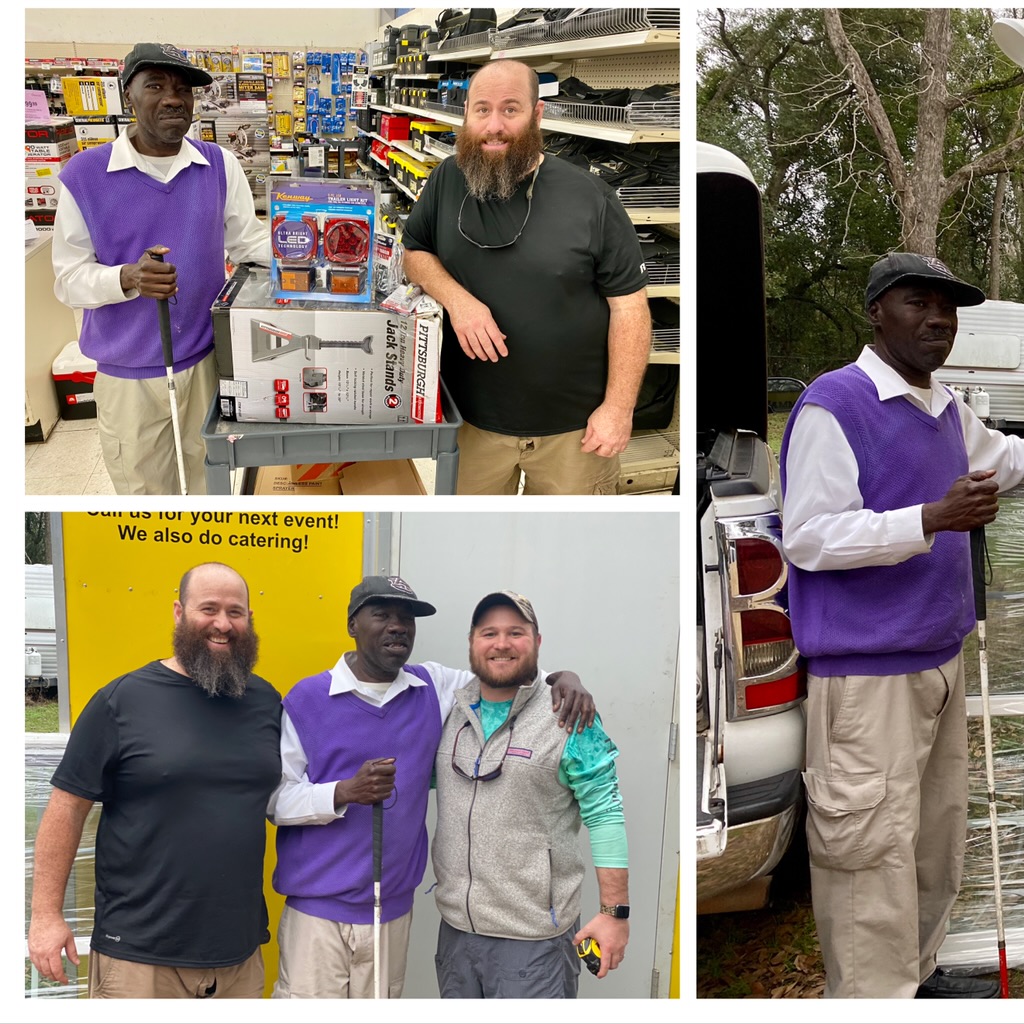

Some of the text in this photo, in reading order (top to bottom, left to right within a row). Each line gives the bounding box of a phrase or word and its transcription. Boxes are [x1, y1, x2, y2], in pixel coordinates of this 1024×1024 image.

[276, 193, 312, 202] Kenway
[277, 235, 311, 244] LED
[384, 320, 398, 392] Jack Stands
[398, 345, 407, 366] Heavy
[416, 323, 429, 397] PITTSBURGH
[397, 367, 406, 384] Duty
[189, 512, 233, 526] your
[238, 512, 278, 526] next
[283, 514, 340, 530] event!
[117, 524, 309, 553] We also do catering!
